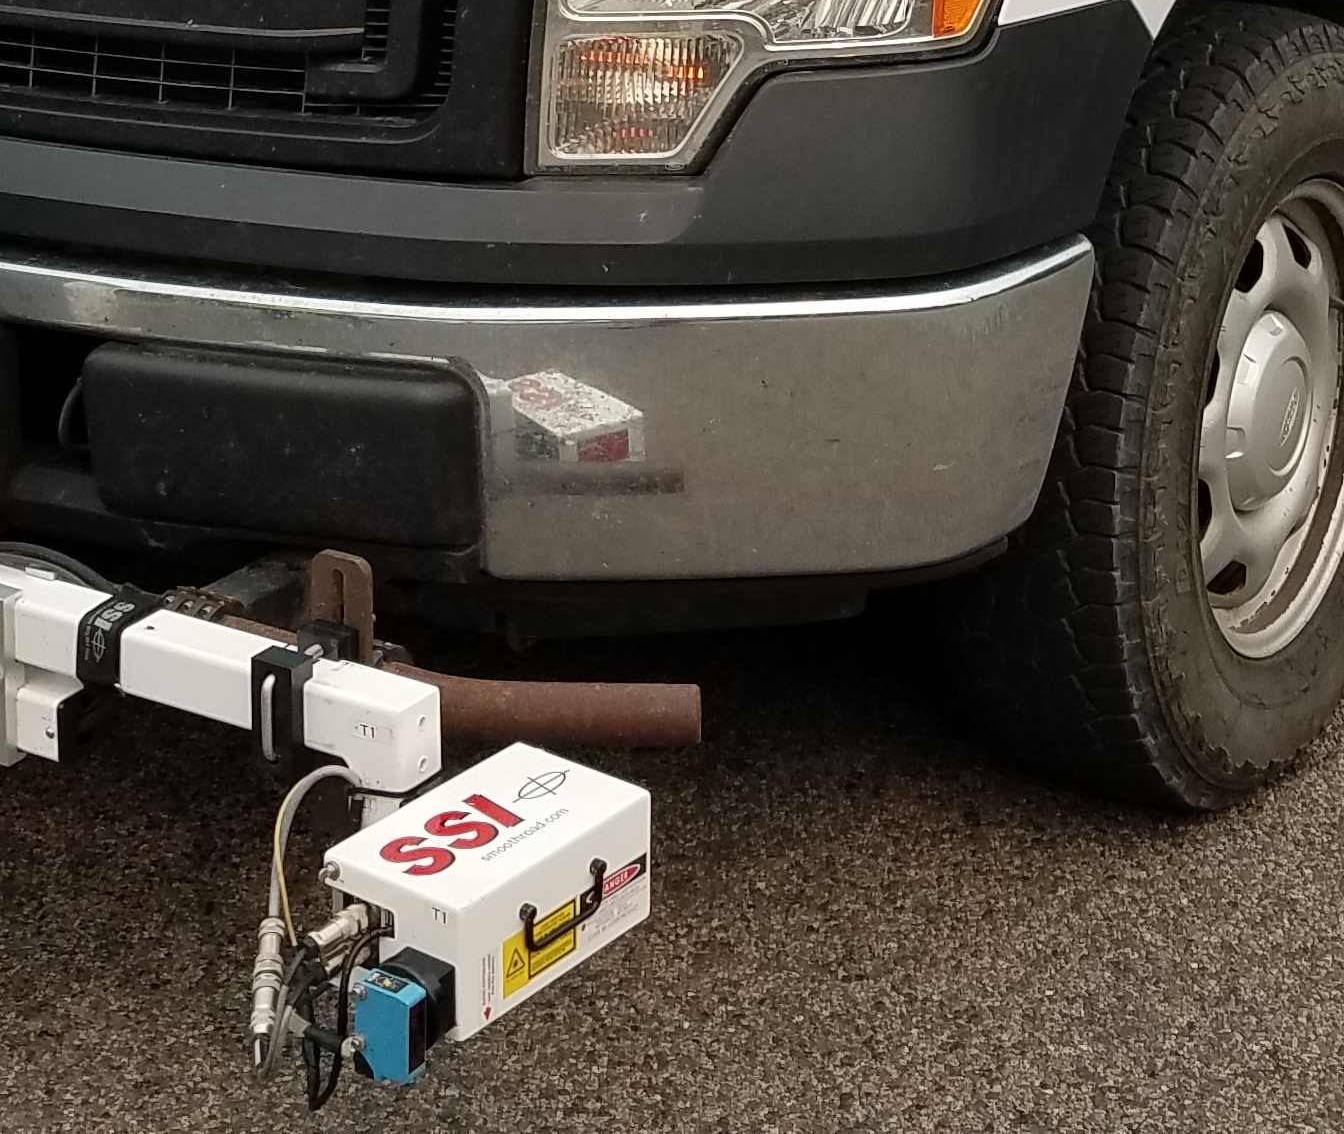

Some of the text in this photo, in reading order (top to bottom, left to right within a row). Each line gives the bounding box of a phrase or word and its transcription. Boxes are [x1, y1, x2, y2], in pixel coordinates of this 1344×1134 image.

[93, 601, 136, 632] SSI
[359, 723, 376, 739] T1
[379, 793, 526, 876] SSI
[481, 808, 570, 862] smoothroad.com
[431, 906, 448, 924] T1
